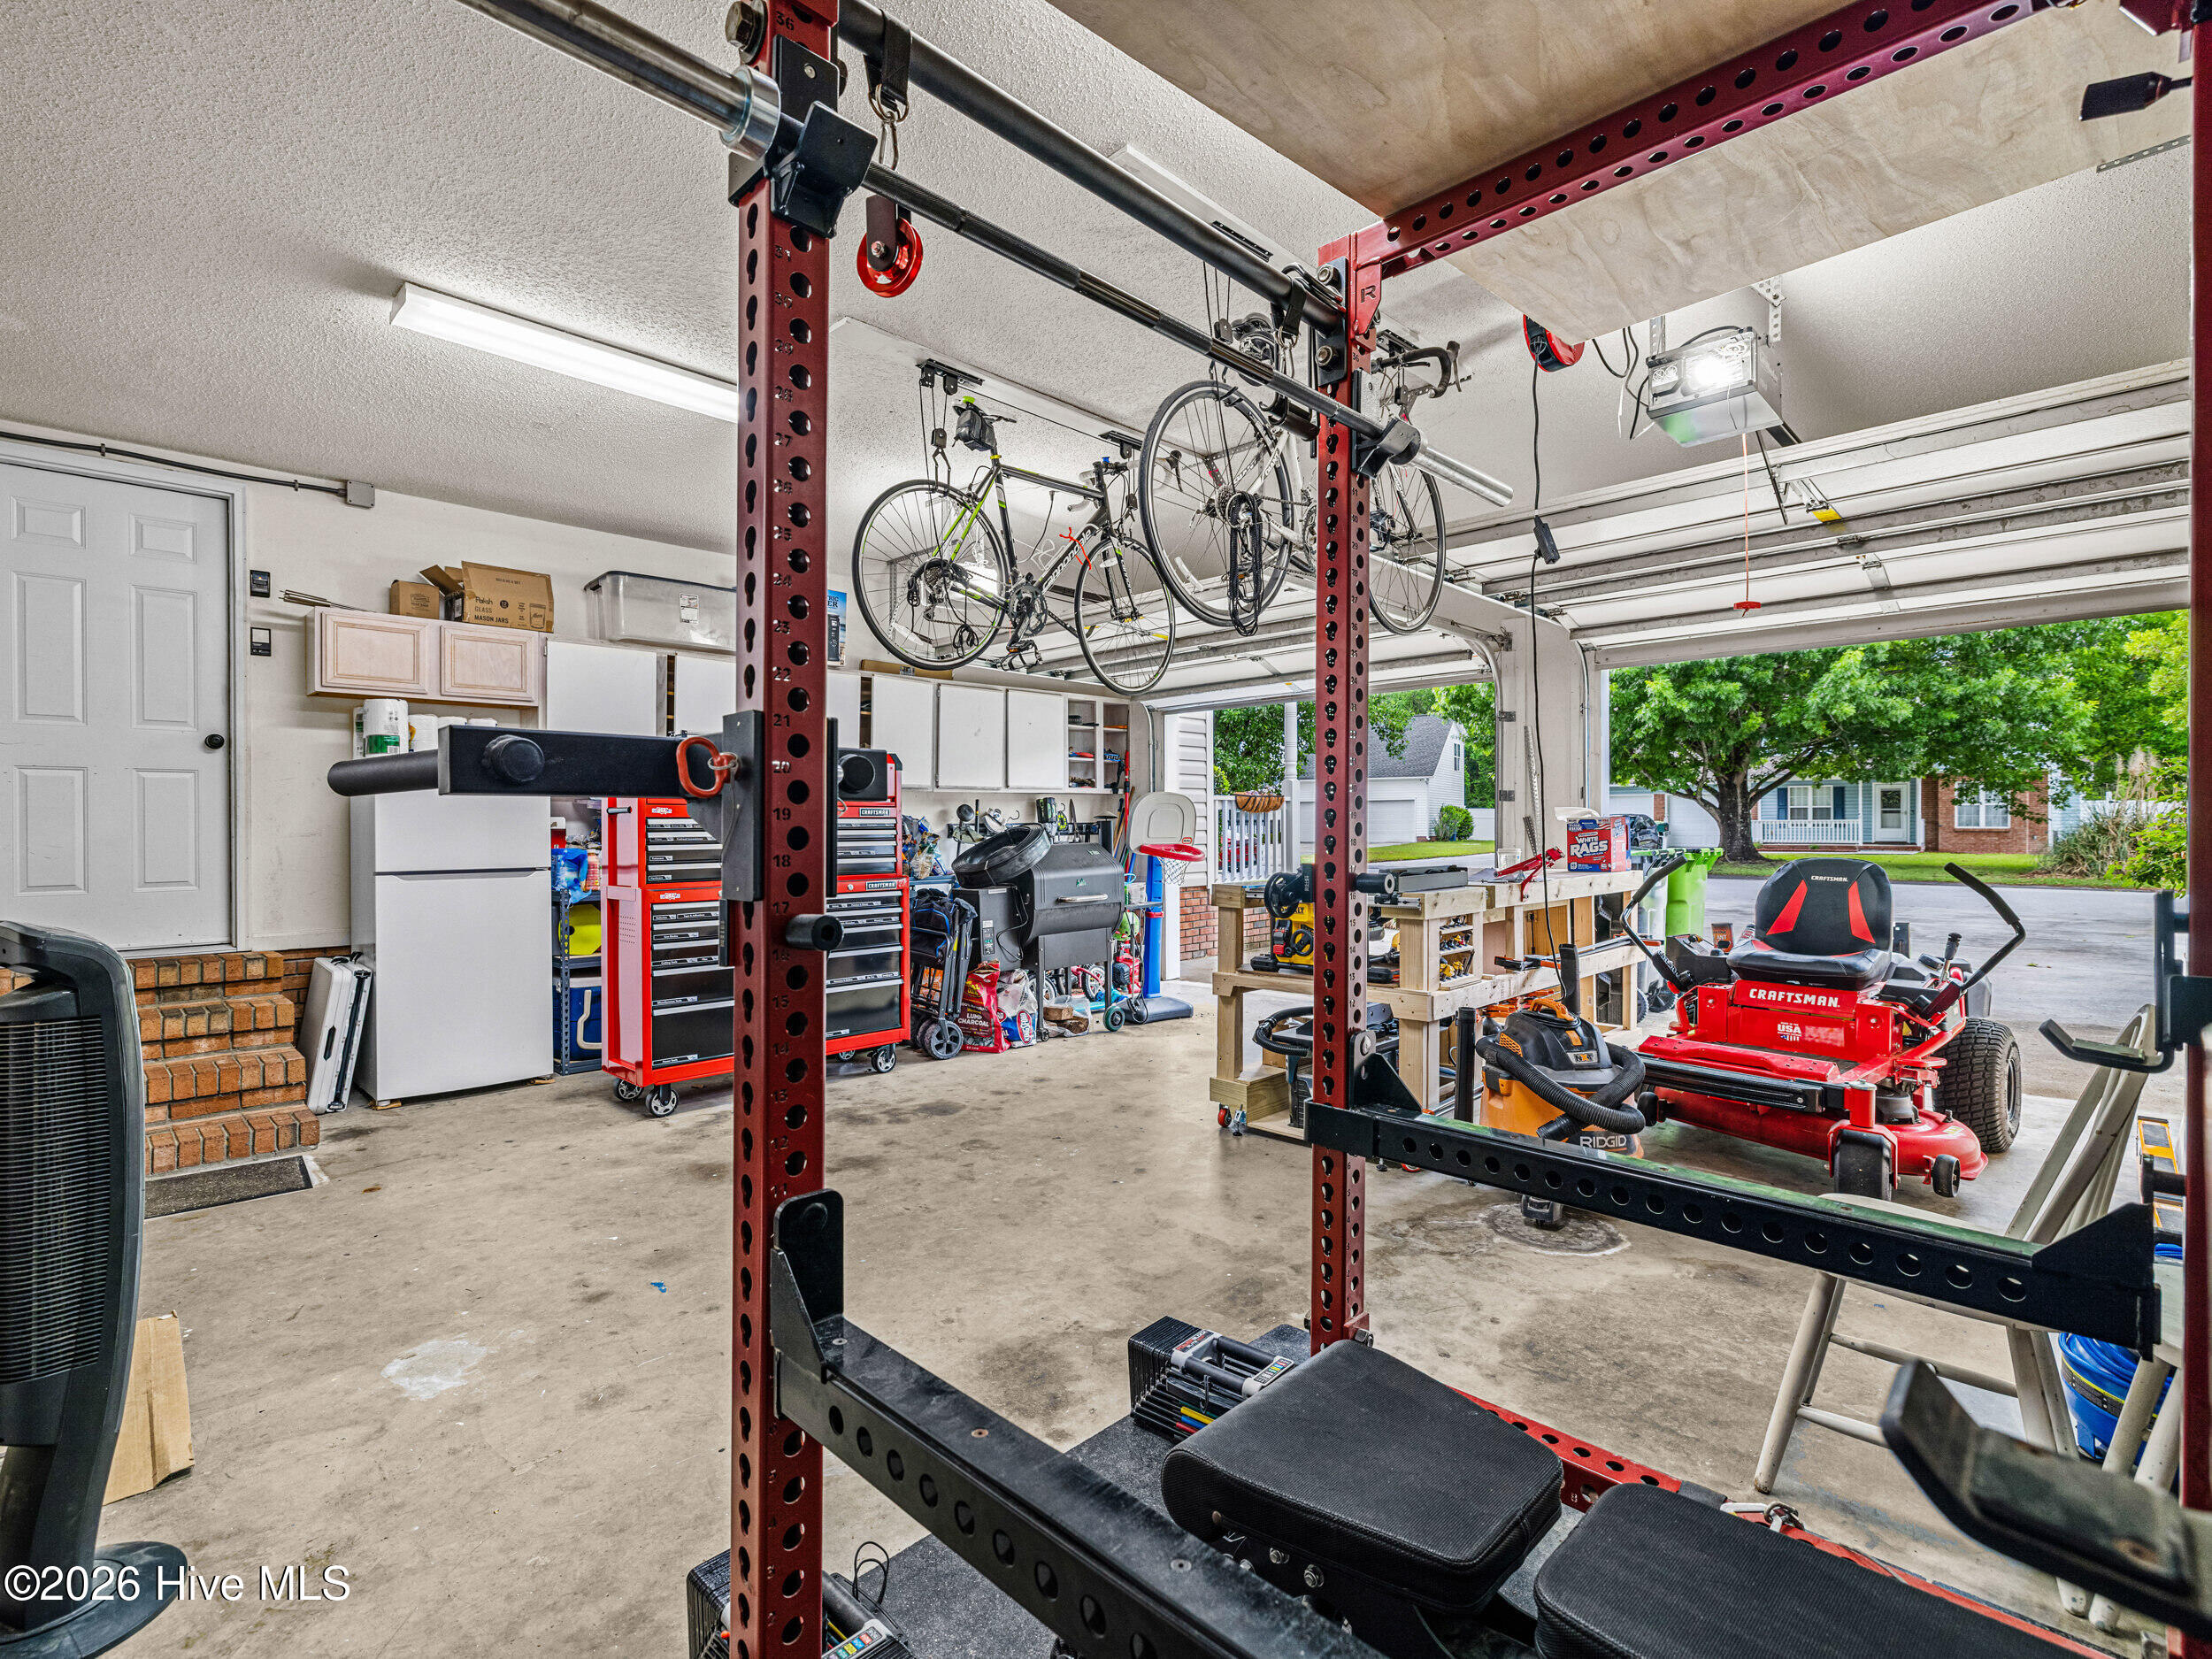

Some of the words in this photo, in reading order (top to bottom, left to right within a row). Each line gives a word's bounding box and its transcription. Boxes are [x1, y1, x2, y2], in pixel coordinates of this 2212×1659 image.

[775, 11, 795, 32] 36
[773, 432, 793, 447] 27
[773, 479, 793, 495] 26
[772, 526, 793, 541] 25
[1042, 529, 1092, 592] cannondale
[772, 572, 793, 588] 24
[474, 614, 494, 623] MASON
[772, 619, 791, 634] 23
[772, 666, 792, 681] 22
[772, 714, 792, 727] 21
[772, 760, 791, 774] 20
[772, 807, 792, 821] 19
[1350, 838, 1357, 847] 18
[1570, 840, 1609, 857] RAGS
[772, 854, 791, 867] 18
[772, 901, 790, 915] 17
[772, 995, 789, 1009] 15
[1749, 988, 1840, 1008] CRAFTSMAN
[957, 1018, 989, 1027] CHARCOAL
[1019, 1012, 1030, 1041] KINGSFORD
[1778, 1024, 1801, 1034] USA
[772, 1042, 789, 1056] 14
[1574, 1053, 1594, 1063] NXT
[772, 1089, 787, 1103] 13
[771, 1135, 789, 1150] 12
[1579, 1135, 1627, 1148] RIDGID
